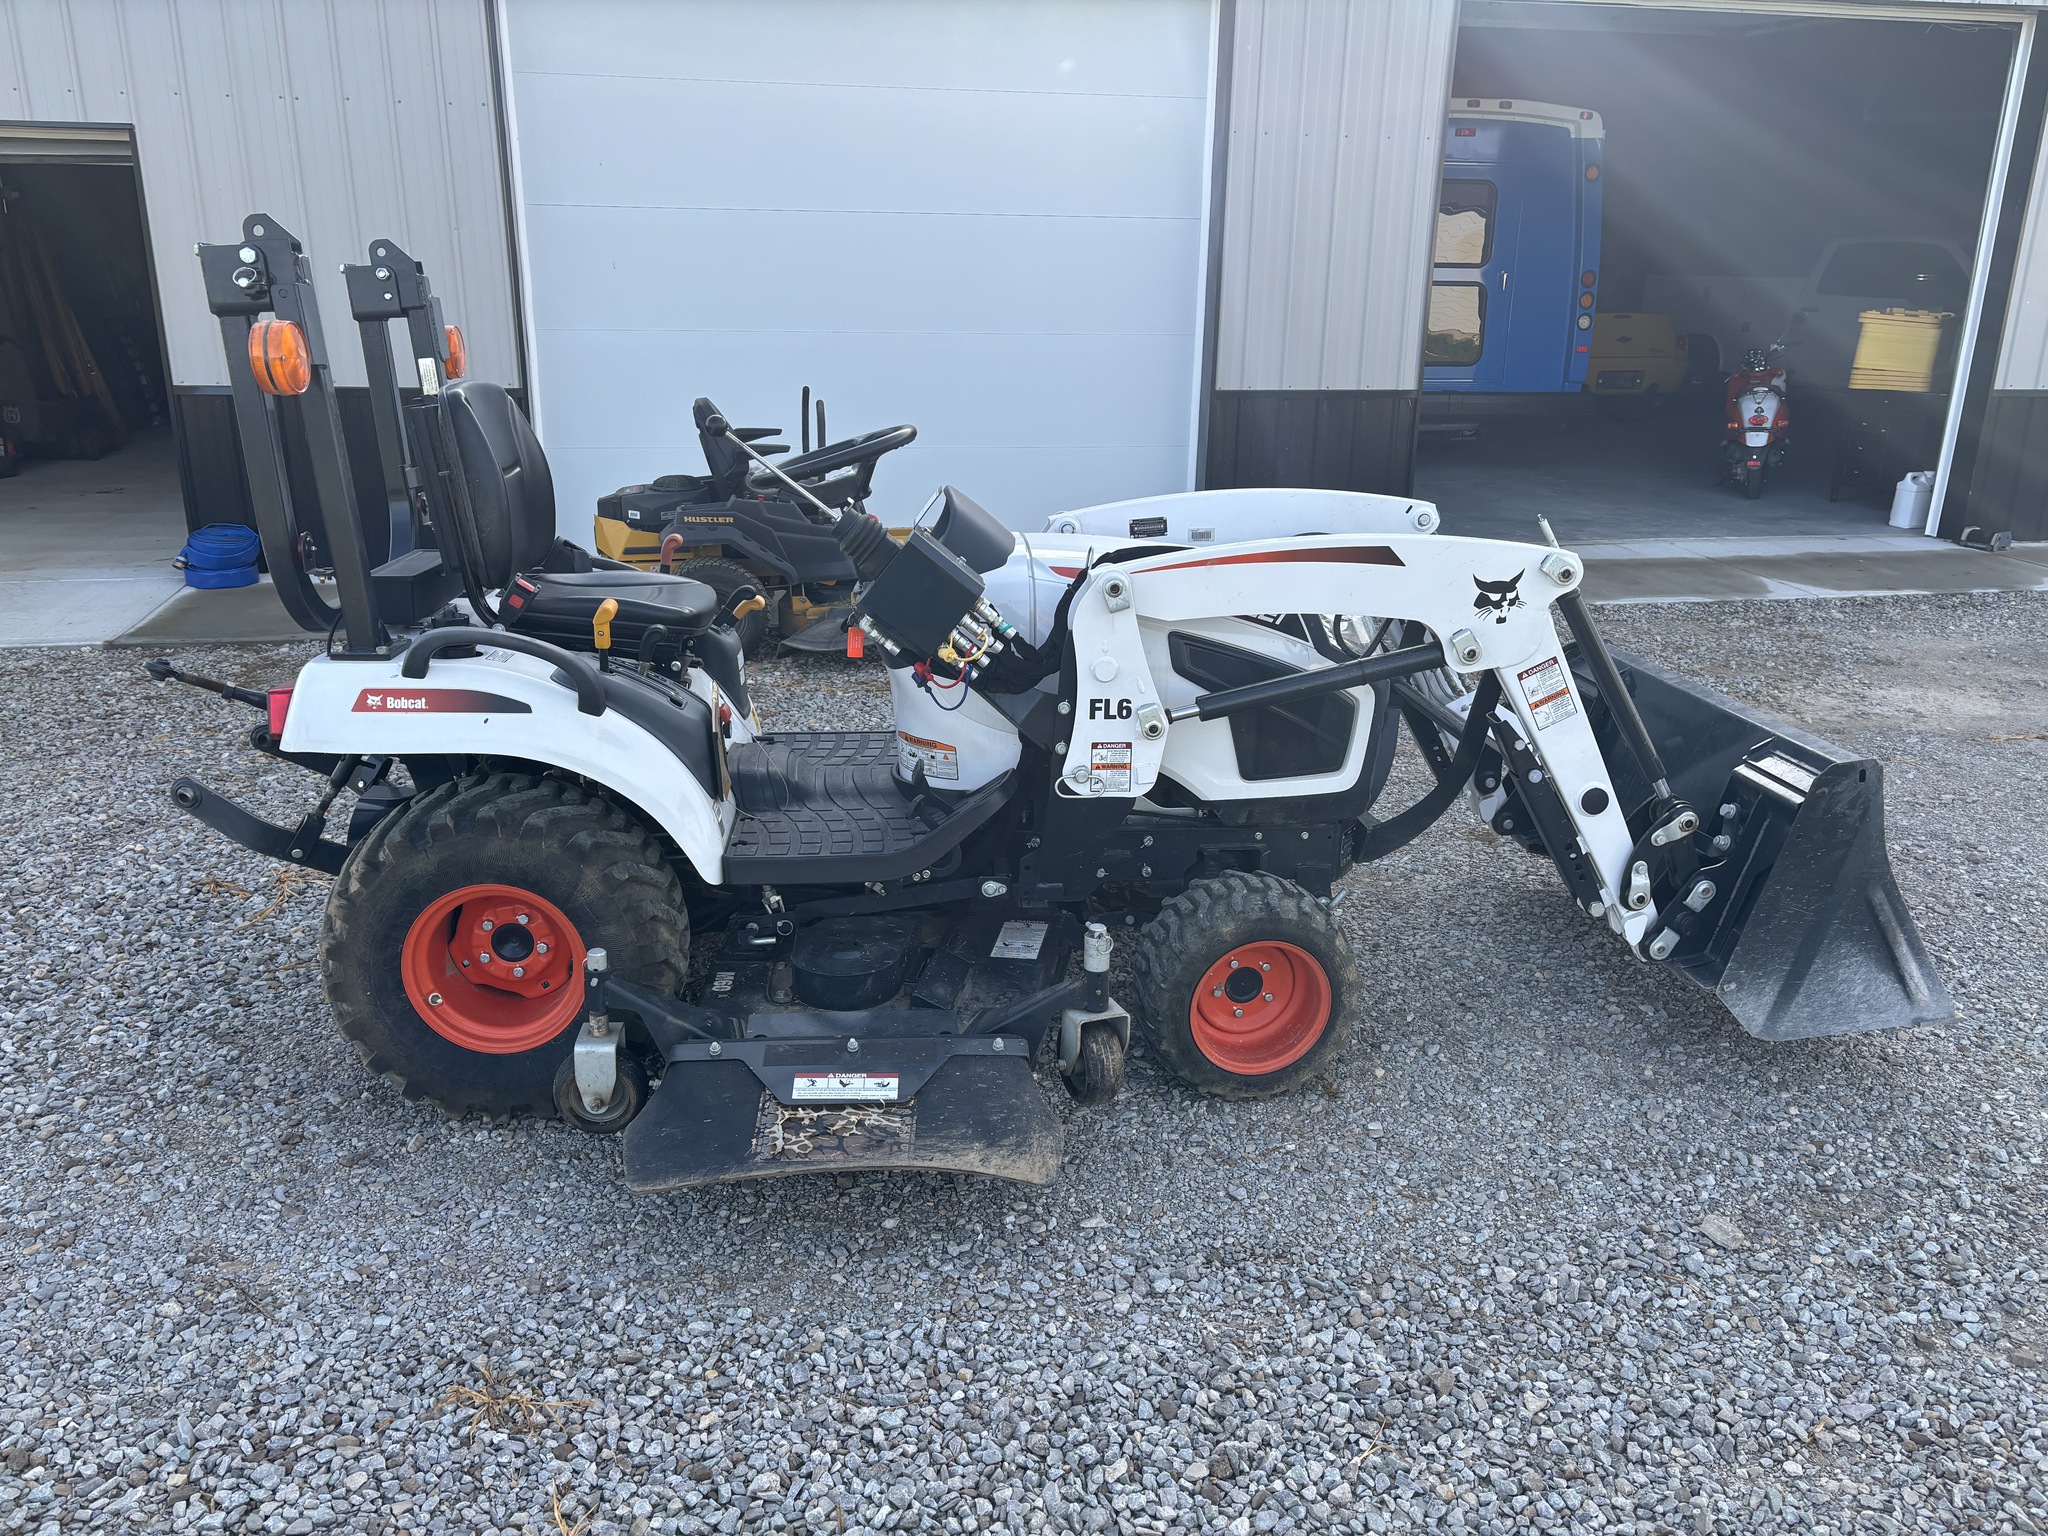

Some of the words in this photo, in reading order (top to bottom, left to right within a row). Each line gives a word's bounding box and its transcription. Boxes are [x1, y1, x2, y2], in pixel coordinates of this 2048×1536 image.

[1528, 659, 1555, 675] DANGER
[386, 696, 427, 709] Bobcat
[1538, 690, 1566, 706] WARNING
[1089, 698, 1132, 720] FL6
[909, 736, 938, 749] WARNING
[711, 971, 736, 991] M60
